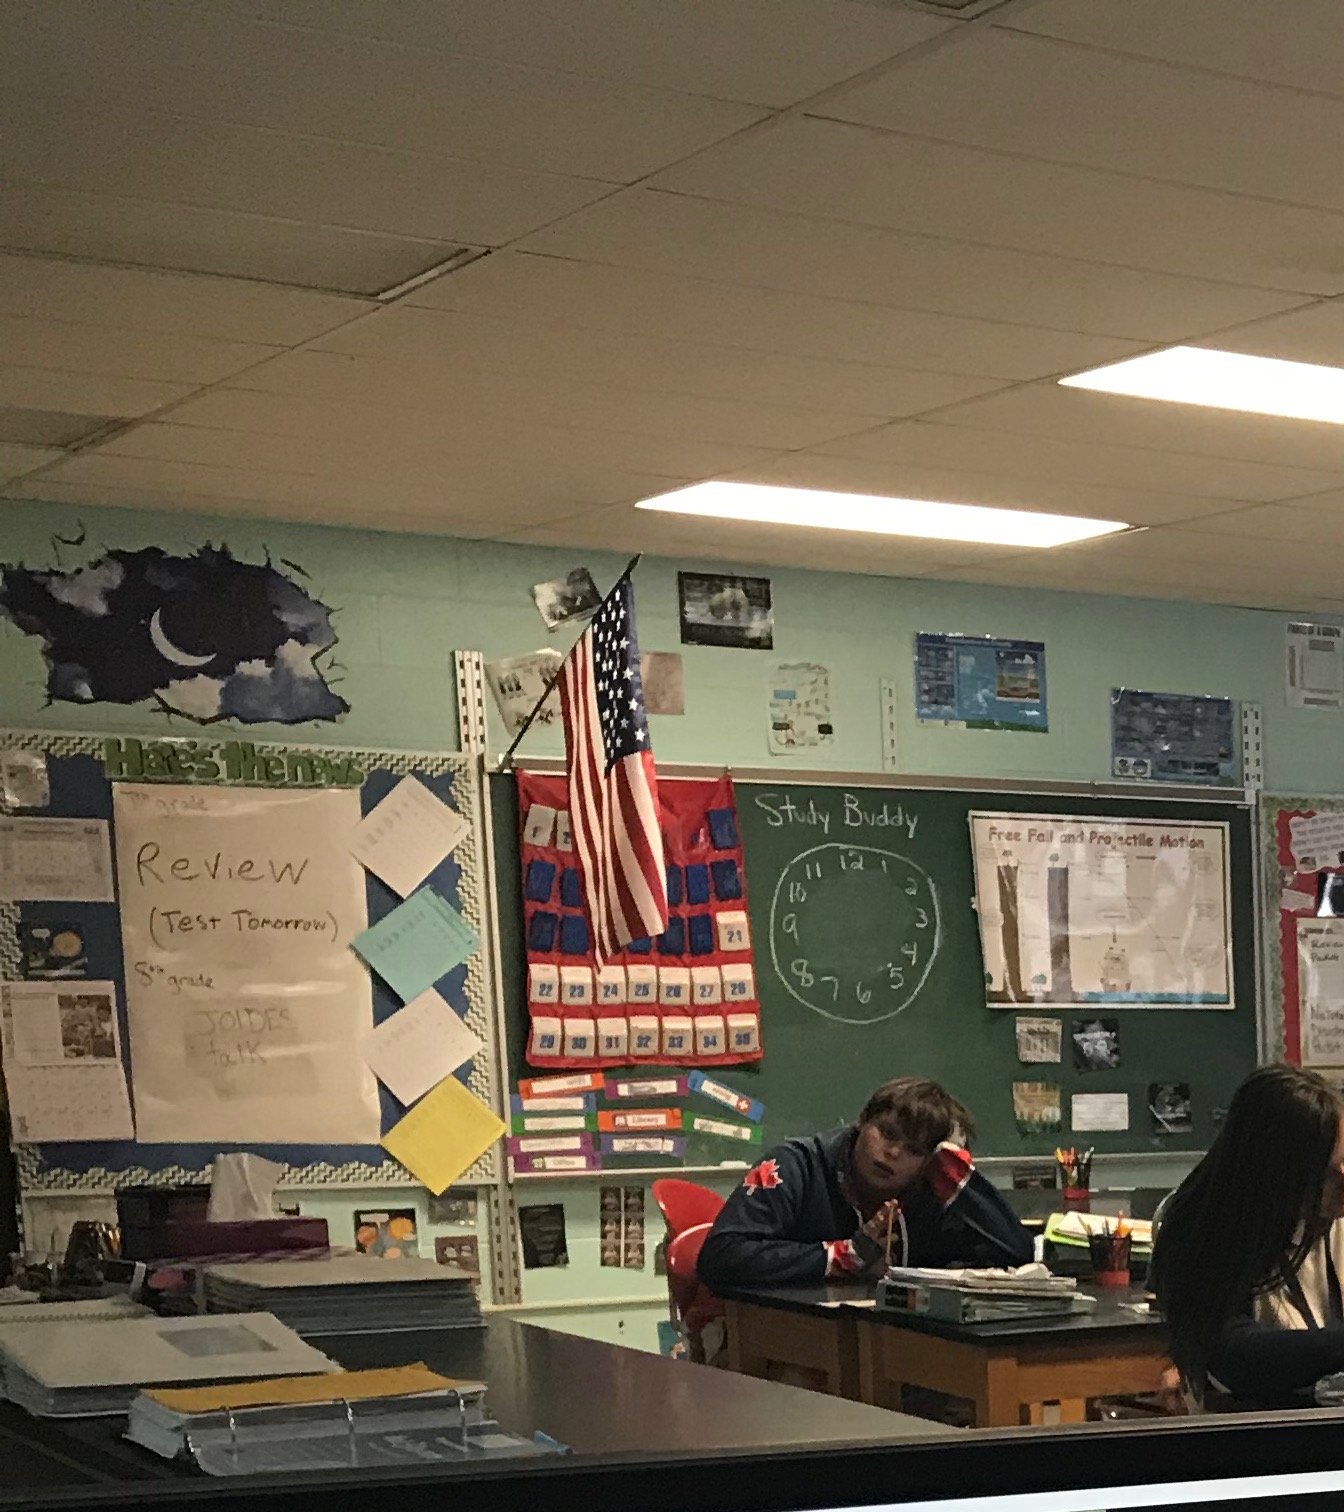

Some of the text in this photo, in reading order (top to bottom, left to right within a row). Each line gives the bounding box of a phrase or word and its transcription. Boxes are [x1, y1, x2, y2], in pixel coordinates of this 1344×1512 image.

[755, 793, 918, 839] Study Buddy
[988, 826, 1022, 843] Free
[1027, 827, 1054, 845] Fall
[1060, 829, 1085, 845] and
[1159, 833, 1205, 849] Motion
[136, 841, 311, 887] Review
[806, 862, 822, 880] 11
[840, 850, 864, 870] 12
[881, 859, 888, 873] 1
[789, 881, 807, 903] 10
[904, 877, 917, 896] 2
[150, 906, 339, 951] (Test Tomorrow)
[915, 907, 928, 928] 3
[727, 930, 743, 944] 21
[782, 913, 800, 946] 9
[901, 941, 917, 966] 4
[790, 959, 814, 988] 8
[889, 966, 904, 990] 5
[167, 975, 216, 996] grade
[539, 983, 553, 996] 22
[569, 984, 584, 998] 23
[603, 983, 618, 997] 24
[634, 982, 649, 996] 25
[699, 984, 714, 997] 27
[820, 976, 839, 1001] 7
[856, 981, 872, 1004] 6
[208, 1040, 268, 1066] talk
